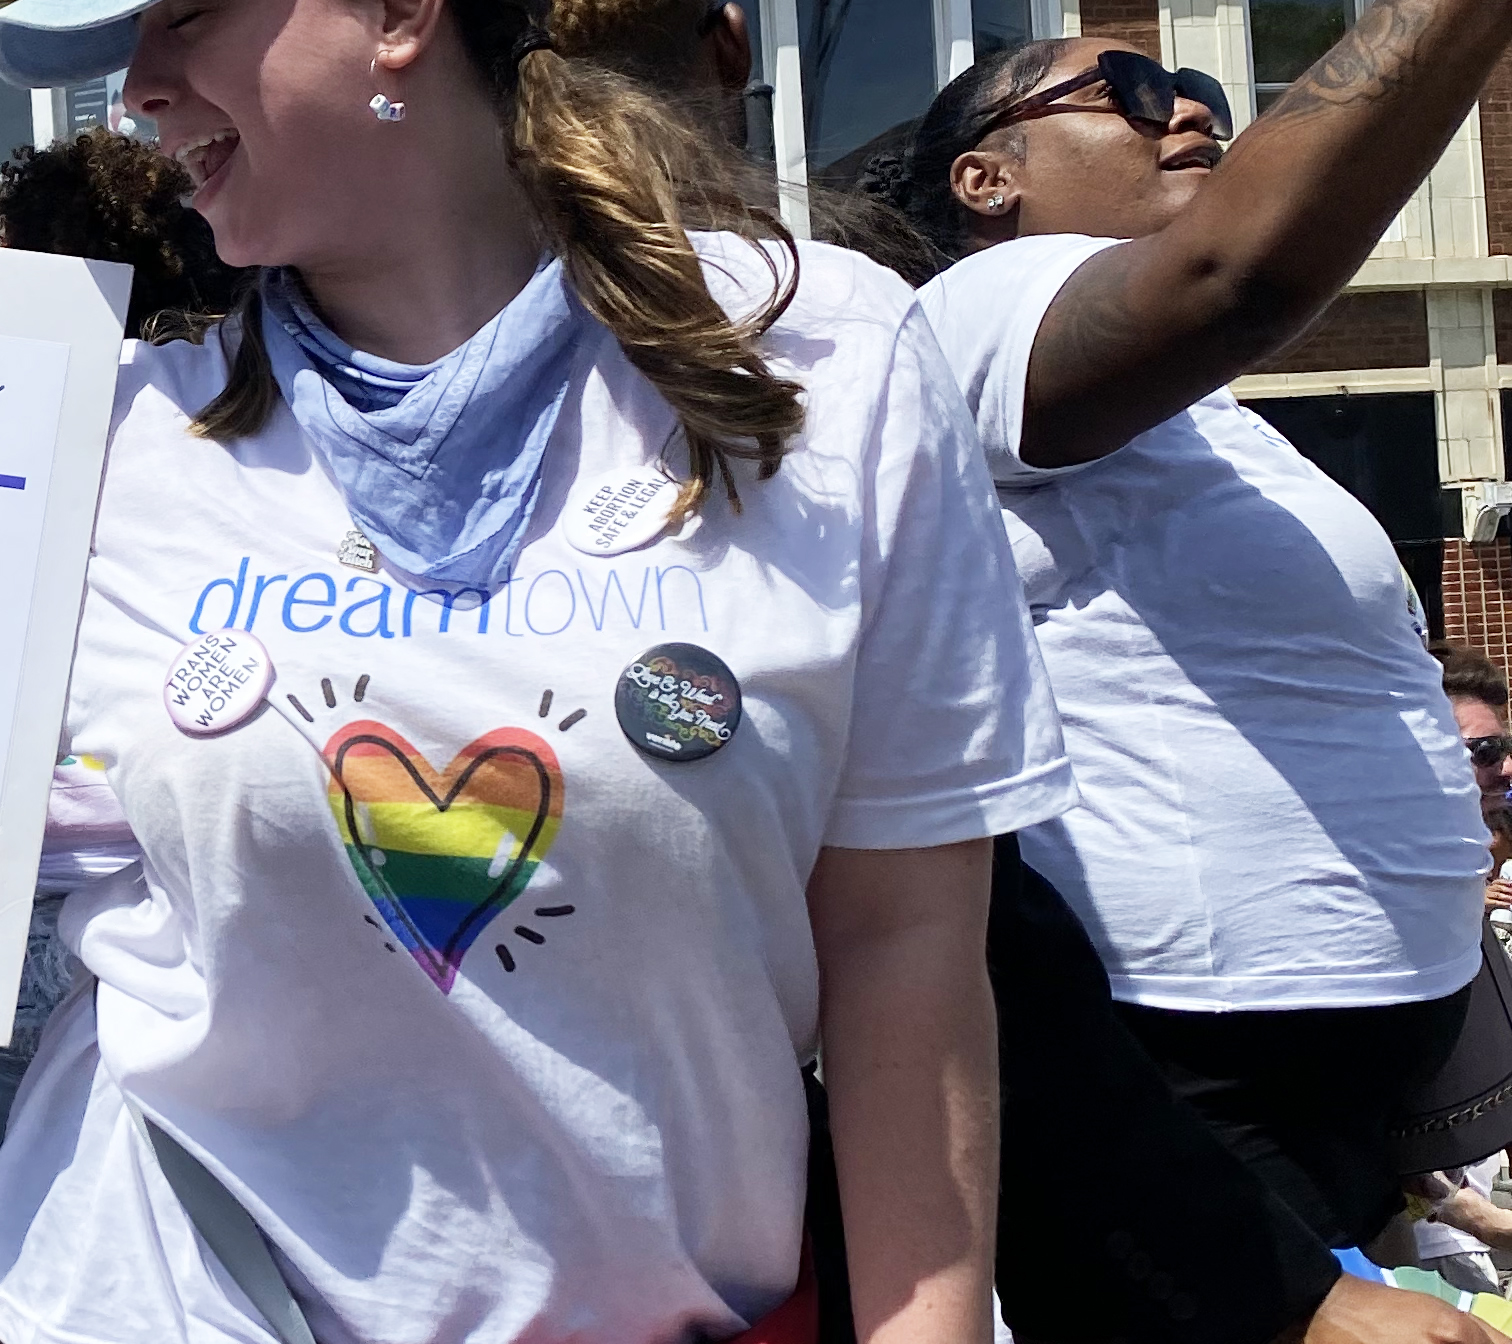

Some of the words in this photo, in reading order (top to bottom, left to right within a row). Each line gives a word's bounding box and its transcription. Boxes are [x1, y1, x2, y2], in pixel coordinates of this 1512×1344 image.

[582, 485, 614, 515] KEEP
[588, 478, 645, 533] ABORTION
[620, 509, 639, 520] &
[629, 477, 670, 509] LEGAL
[595, 517, 629, 549] SAFE
[188, 556, 709, 639] dreamtown
[166, 634, 220, 690] TRANS
[172, 637, 238, 706] WOMEN
[202, 662, 236, 700] ARE
[195, 657, 260, 727] WOMEN
